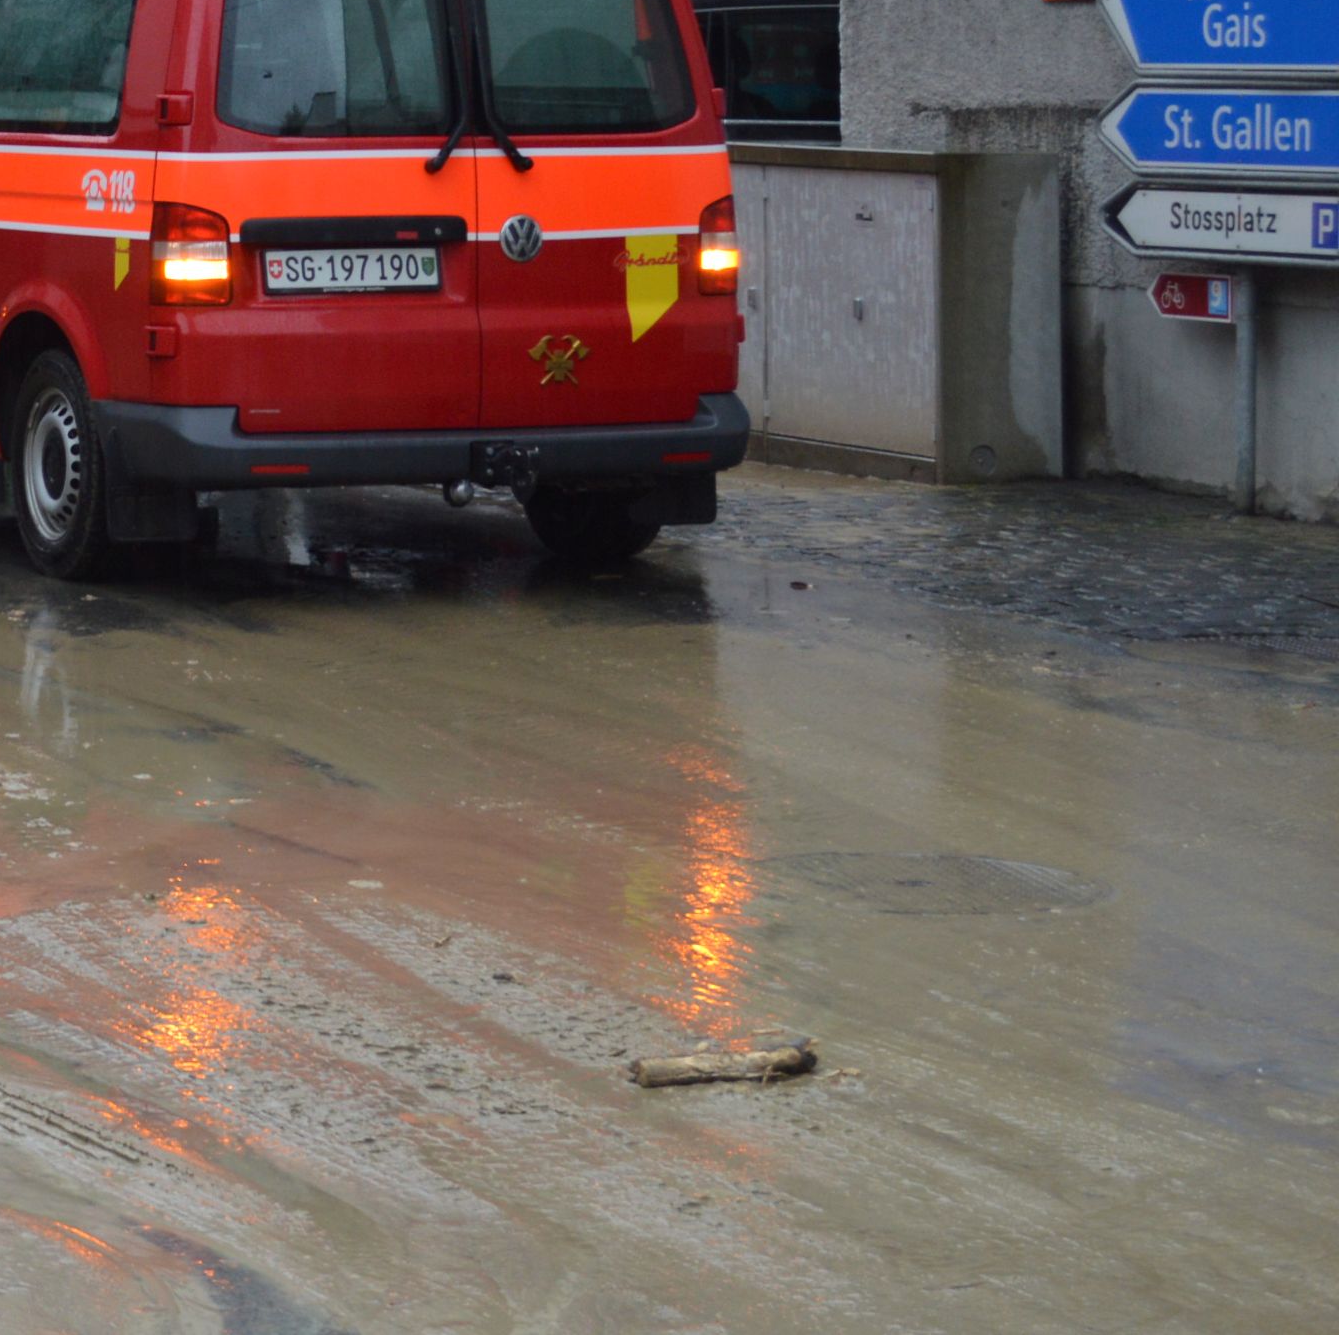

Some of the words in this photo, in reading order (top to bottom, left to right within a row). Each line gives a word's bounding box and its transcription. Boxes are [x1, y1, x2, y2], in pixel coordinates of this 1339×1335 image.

[1203, 2, 1266, 47] Gais
[1164, 104, 1201, 149] St.
[1212, 103, 1311, 152] Gallen
[110, 169, 136, 214] 118
[1170, 202, 1277, 238] Stossplatz
